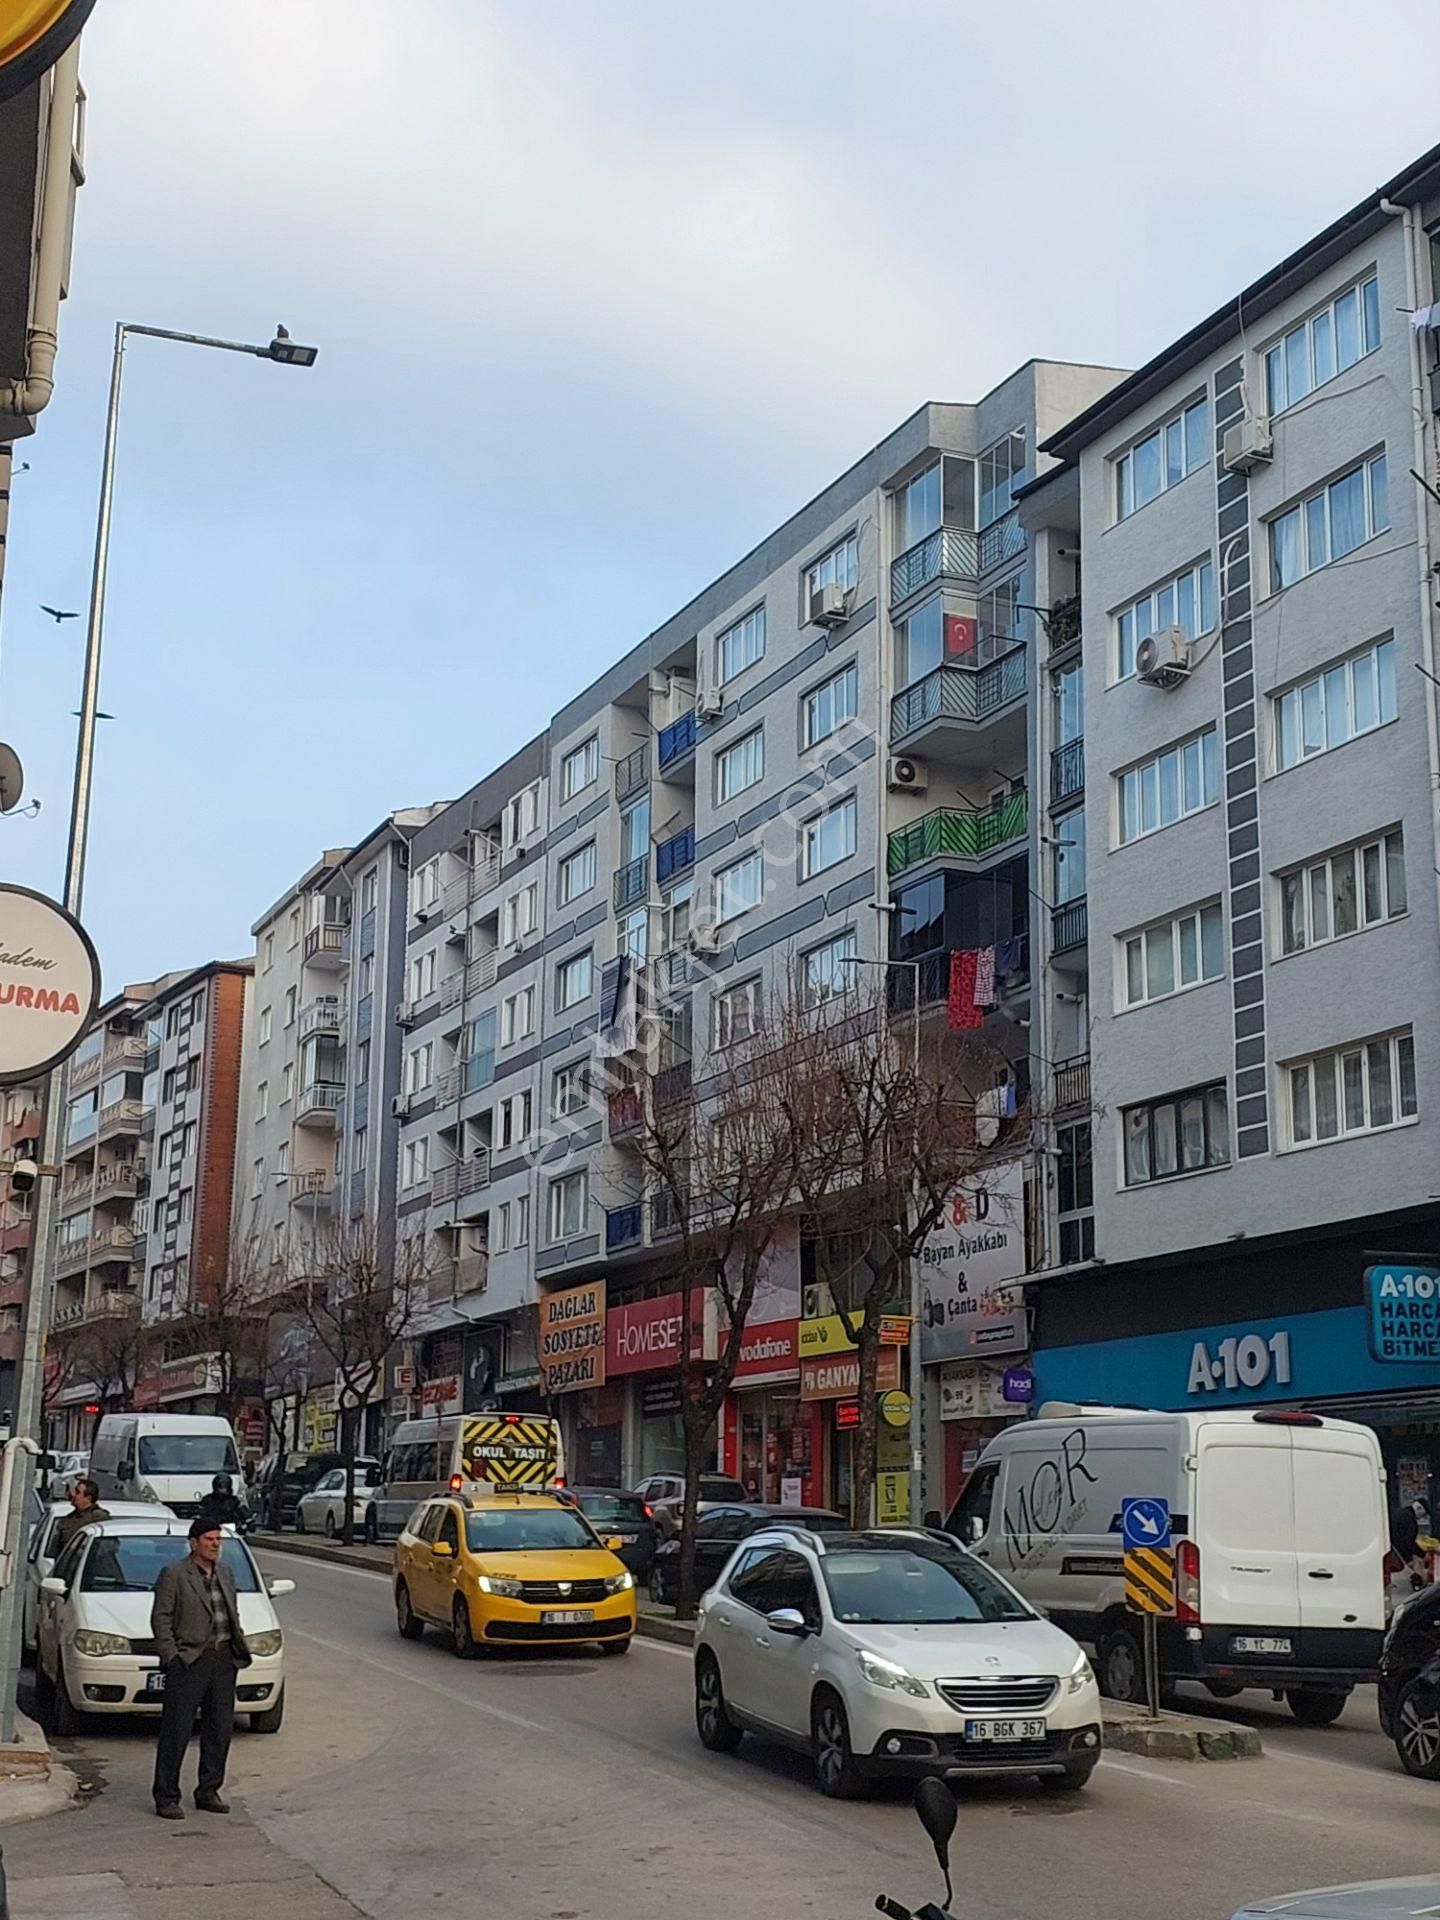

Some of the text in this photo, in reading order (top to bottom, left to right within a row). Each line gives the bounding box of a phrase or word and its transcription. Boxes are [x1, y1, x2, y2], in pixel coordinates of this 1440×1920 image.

[0, 943, 57, 970] adem
[923, 1231, 1008, 1265] Bayan Ayakkabı
[958, 1271, 968, 1294] &
[947, 1297, 978, 1321] Çanta
[543, 1321, 601, 1355] SOSYETE
[740, 1336, 792, 1362] vodafone
[401, 1369, 411, 1383] E
[547, 1356, 595, 1387] PAZARI
[1009, 1377, 1032, 1389] hadi
[473, 1446, 507, 1458] OKUL
[1003, 1427, 1099, 1573] MOR
[974, 1723, 987, 1737] 16
[1022, 1720, 1044, 1736] 367
